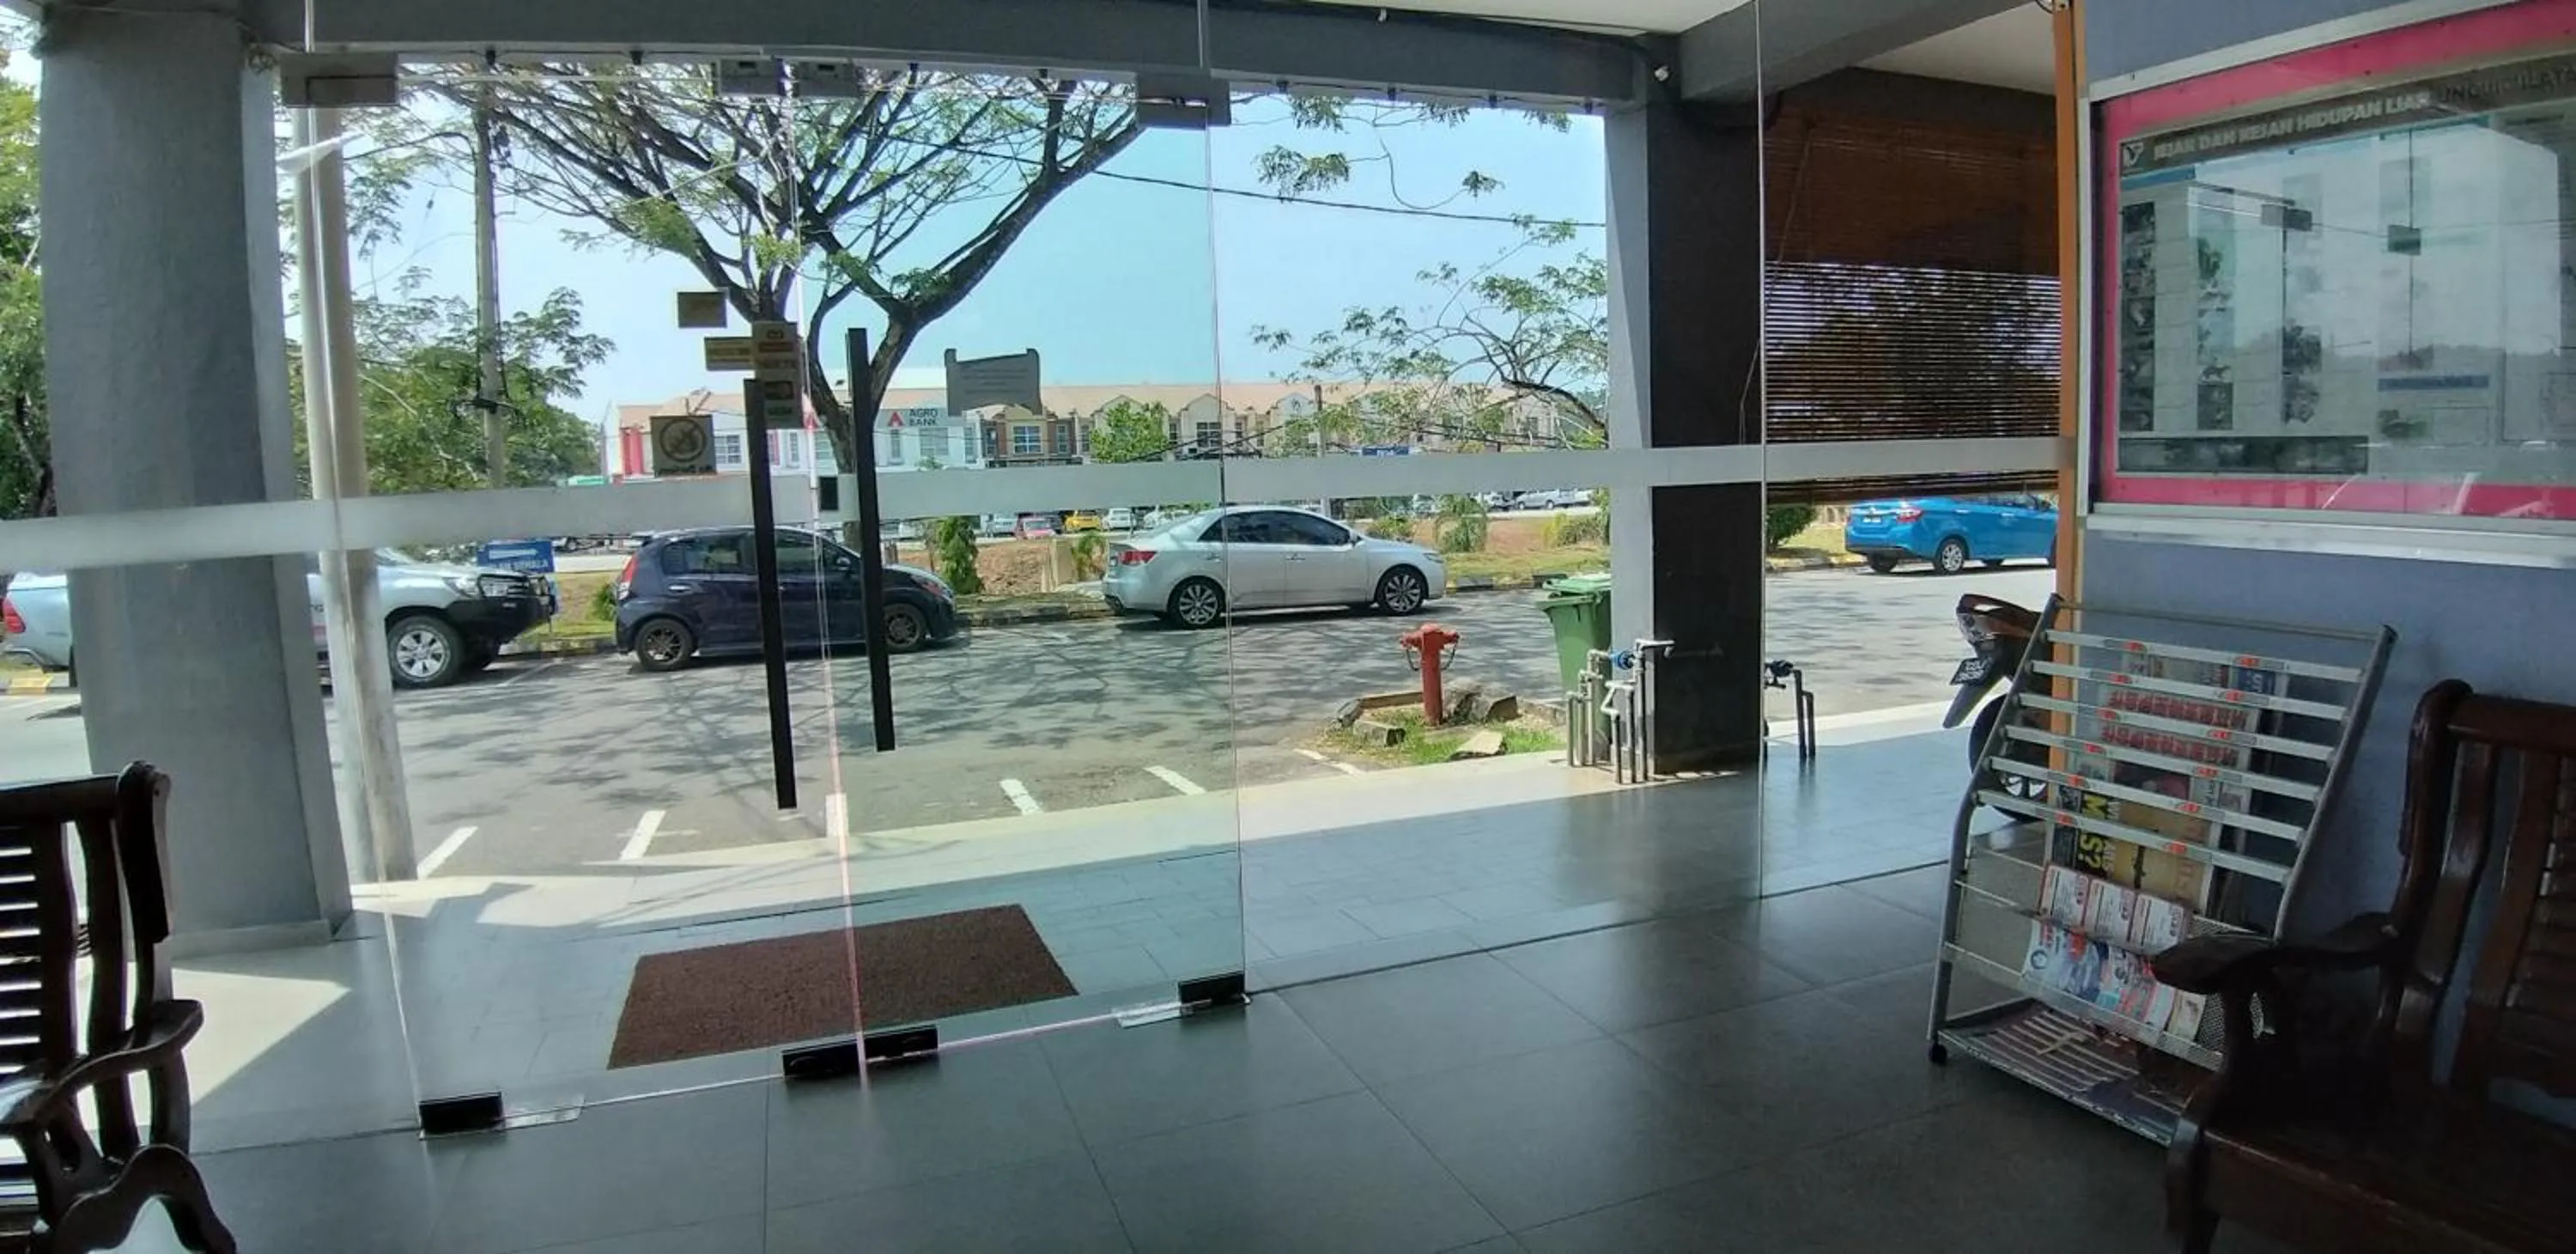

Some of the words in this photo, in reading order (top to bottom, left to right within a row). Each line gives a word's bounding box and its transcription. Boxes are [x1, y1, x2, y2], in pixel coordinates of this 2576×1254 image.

[2198, 130, 2237, 149] DAN
[2296, 100, 2384, 132] HIDUPAN
[908, 408, 939, 417] AGRO
[908, 418, 939, 427] BANK
